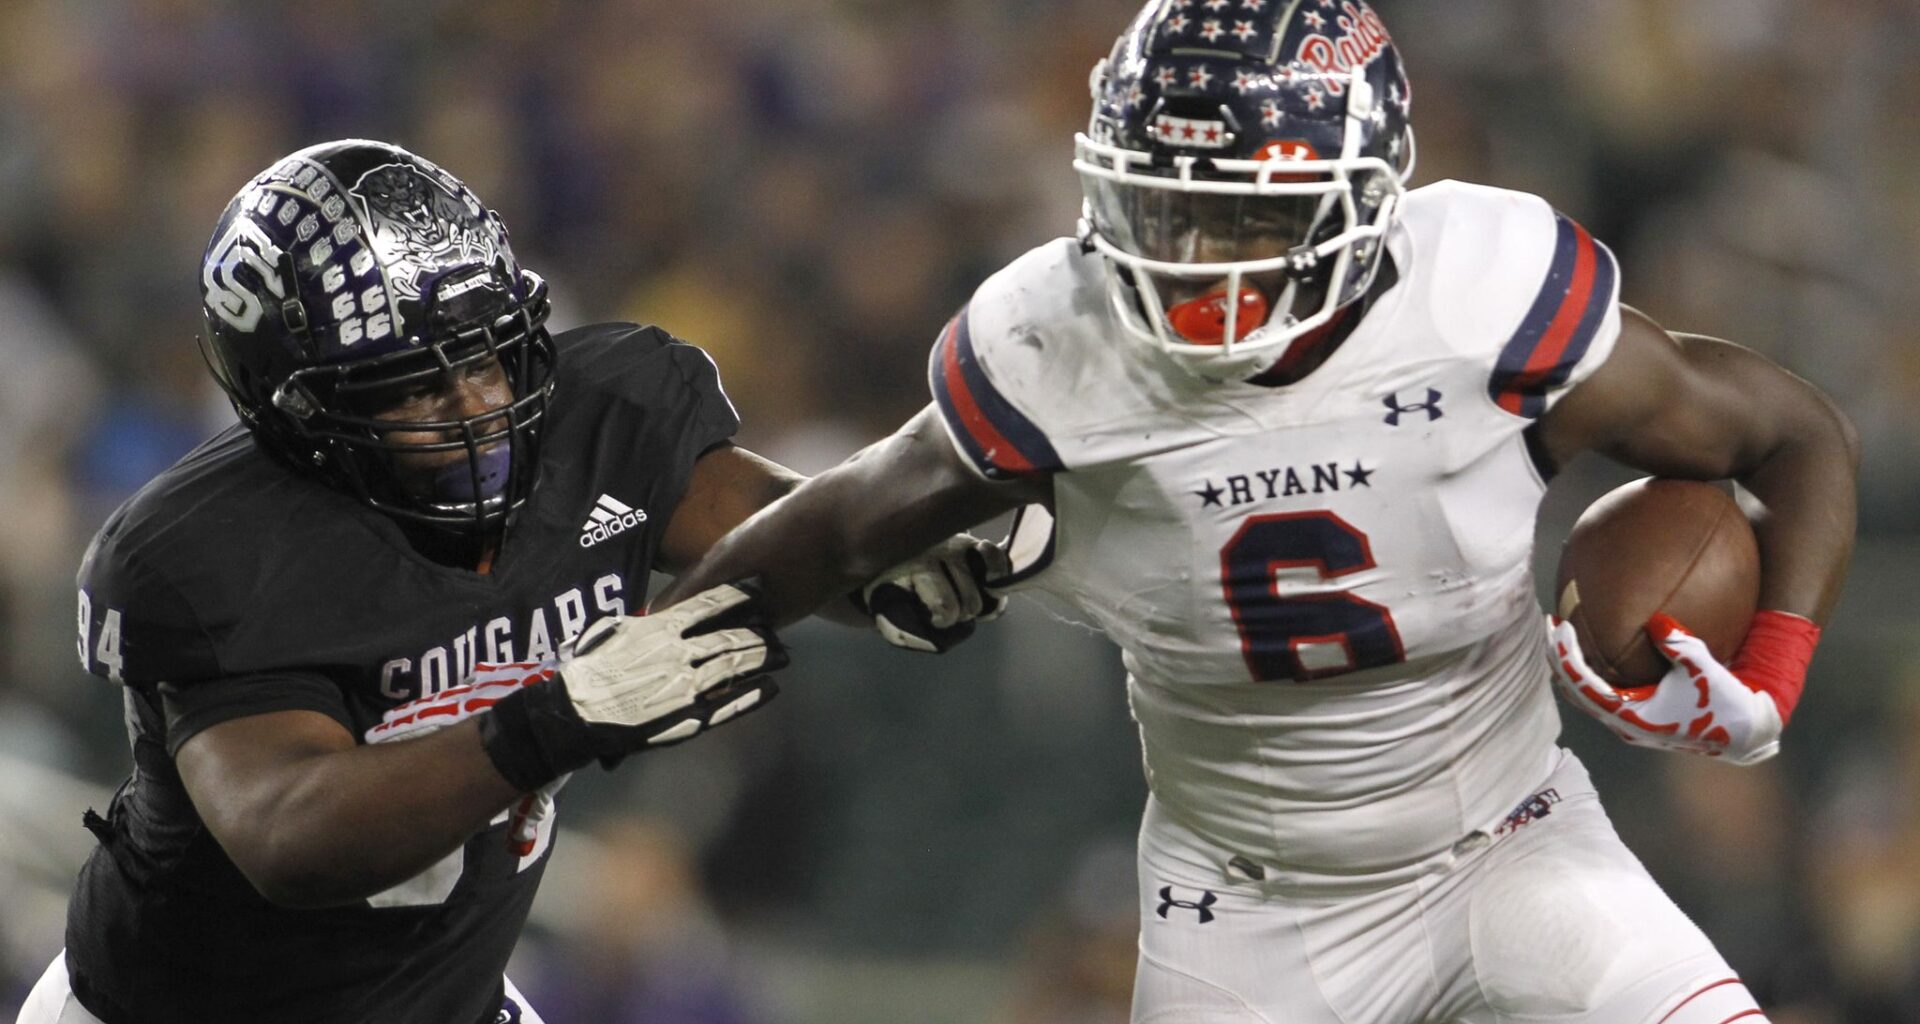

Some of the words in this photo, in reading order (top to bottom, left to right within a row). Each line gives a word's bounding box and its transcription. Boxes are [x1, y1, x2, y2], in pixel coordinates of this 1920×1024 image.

[579, 507, 648, 548] adidas
[1227, 462, 1340, 505] RYAN
[77, 588, 124, 683] 94
[380, 573, 626, 699] COUGARS
[1219, 510, 1407, 683] 6
